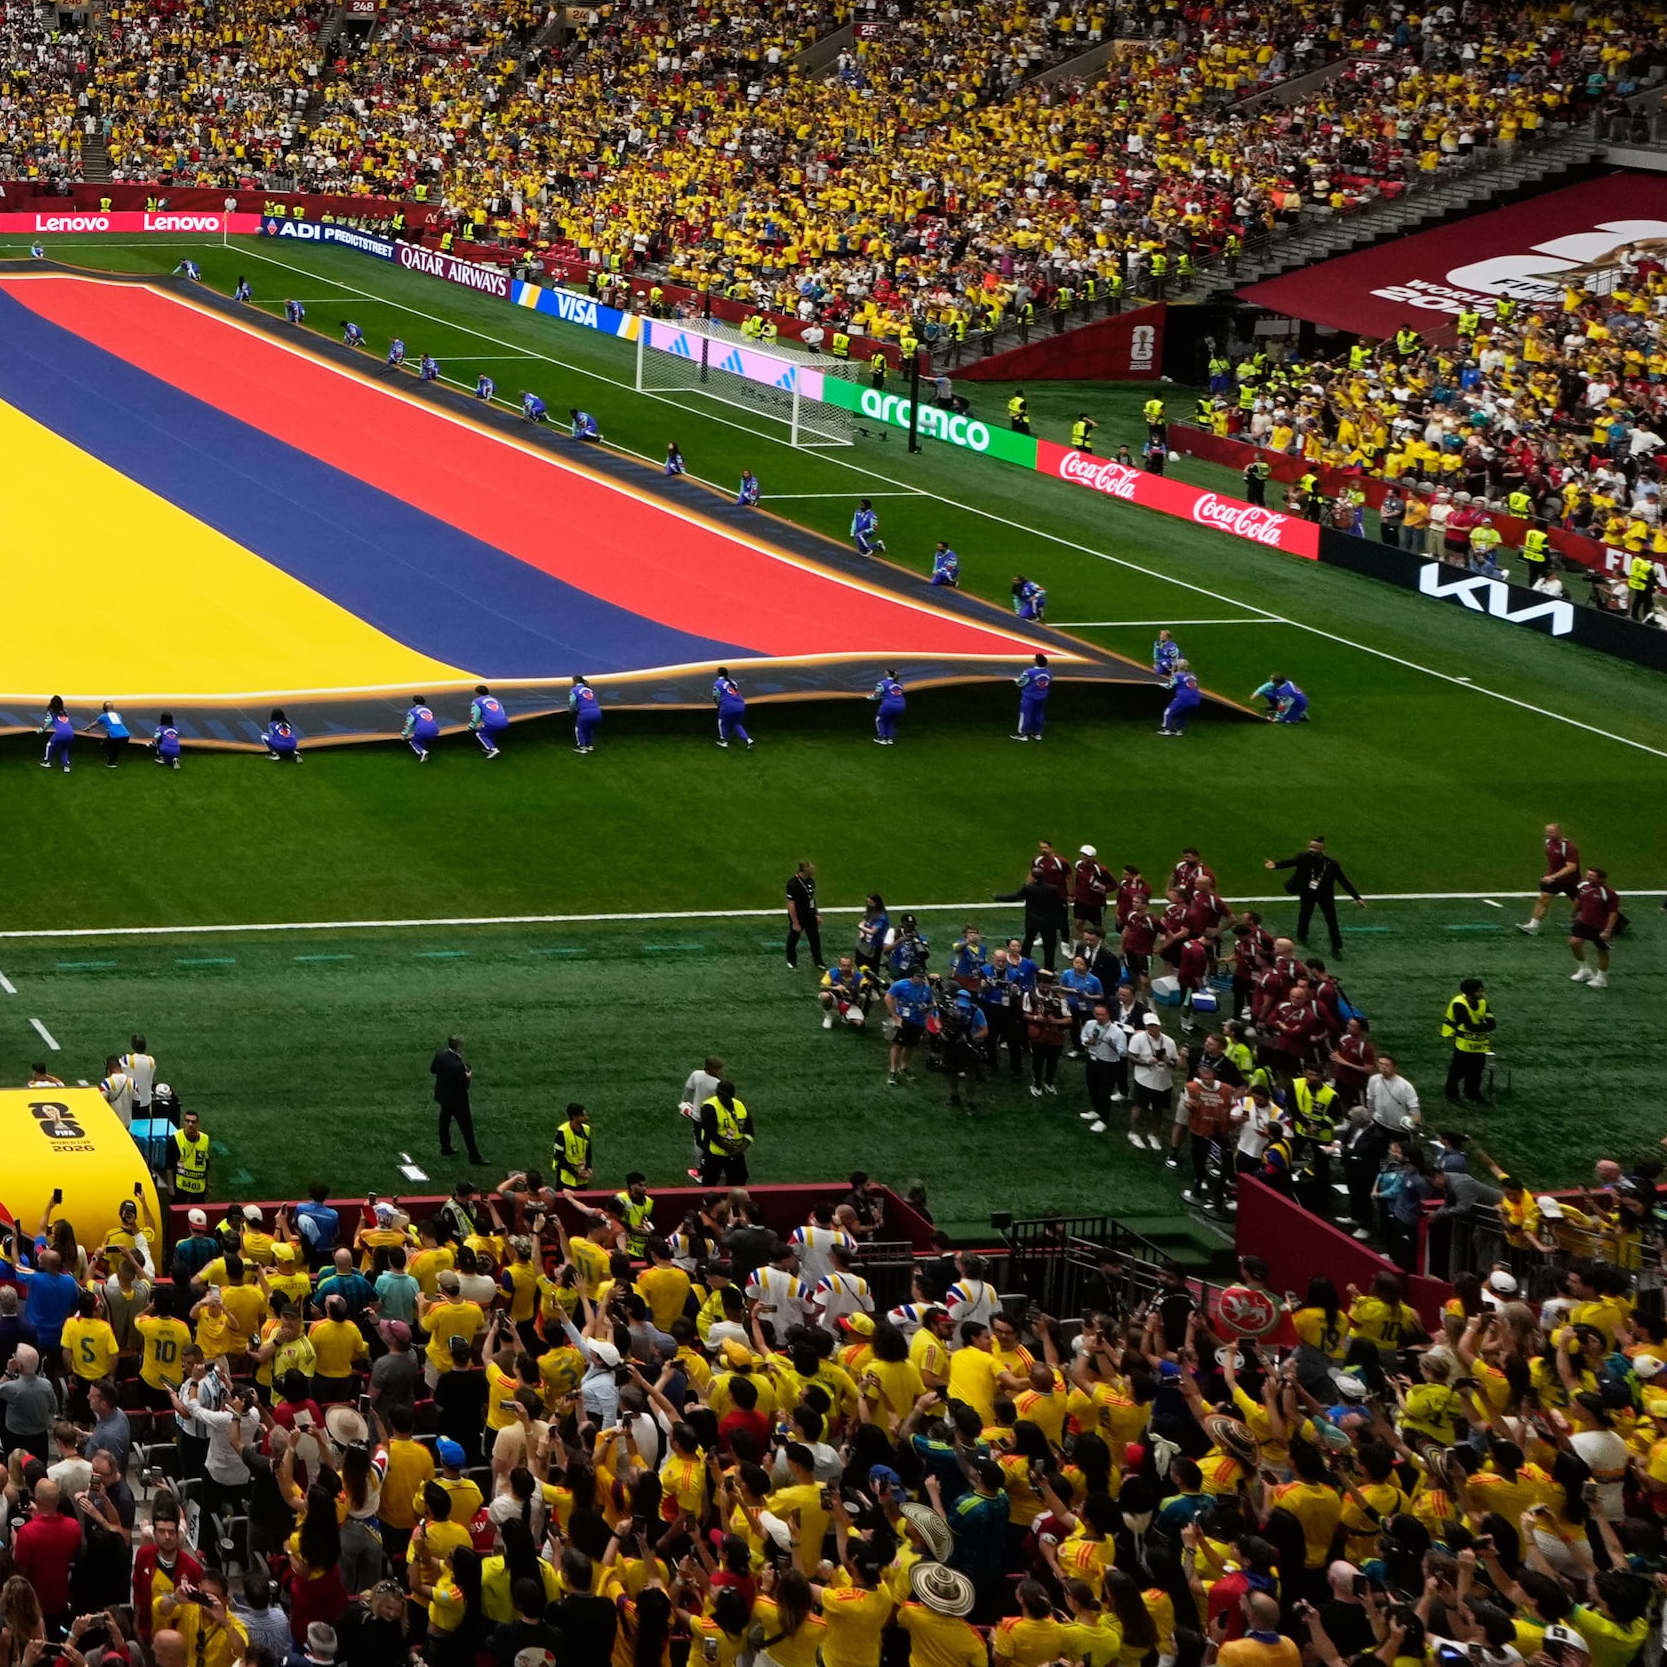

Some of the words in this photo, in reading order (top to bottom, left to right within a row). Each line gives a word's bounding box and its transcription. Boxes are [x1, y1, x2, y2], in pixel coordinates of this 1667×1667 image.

[35, 214, 109, 232] Lenovo
[143, 213, 219, 231] Lenovo
[279, 221, 321, 240] ADI
[324, 226, 395, 258] PREDICTSTREET
[400, 246, 444, 279] QATAR
[447, 257, 507, 297] AIRWAYS
[555, 292, 598, 329] VISA
[1059, 450, 1140, 500] Coca-Cola
[1193, 492, 1286, 548] Coca-Cola
[1419, 562, 1574, 636] KIA
[81, 1337, 95, 1363] 5
[155, 1338, 177, 1363] 10
